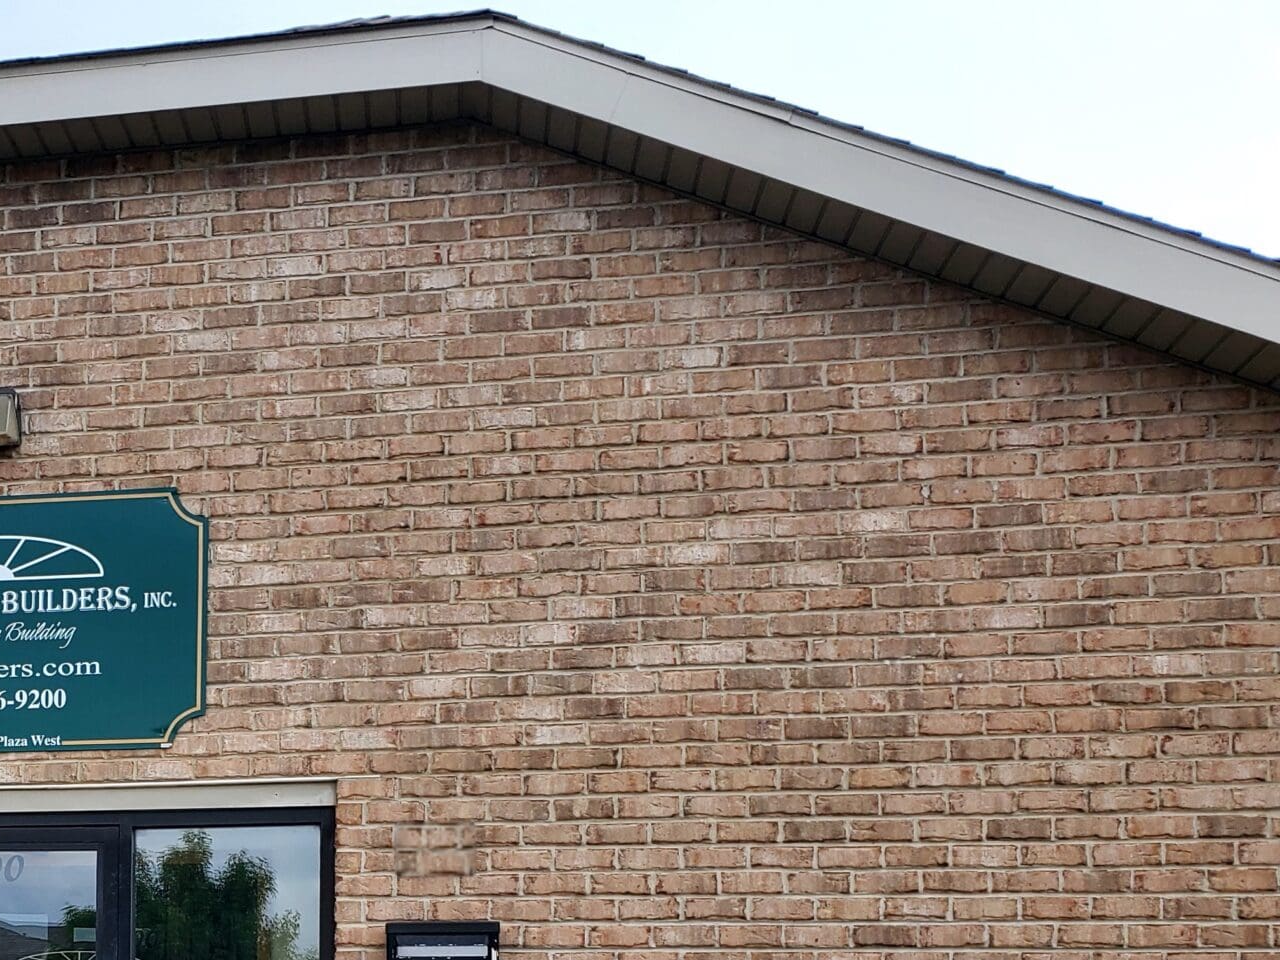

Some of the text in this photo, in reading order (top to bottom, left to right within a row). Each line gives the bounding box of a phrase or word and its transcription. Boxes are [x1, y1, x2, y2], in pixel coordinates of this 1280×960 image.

[1, 586, 138, 616] BUILDERS,
[143, 591, 178, 609] INC.
[5, 621, 77, 649] Building
[30, 734, 62, 747] West
